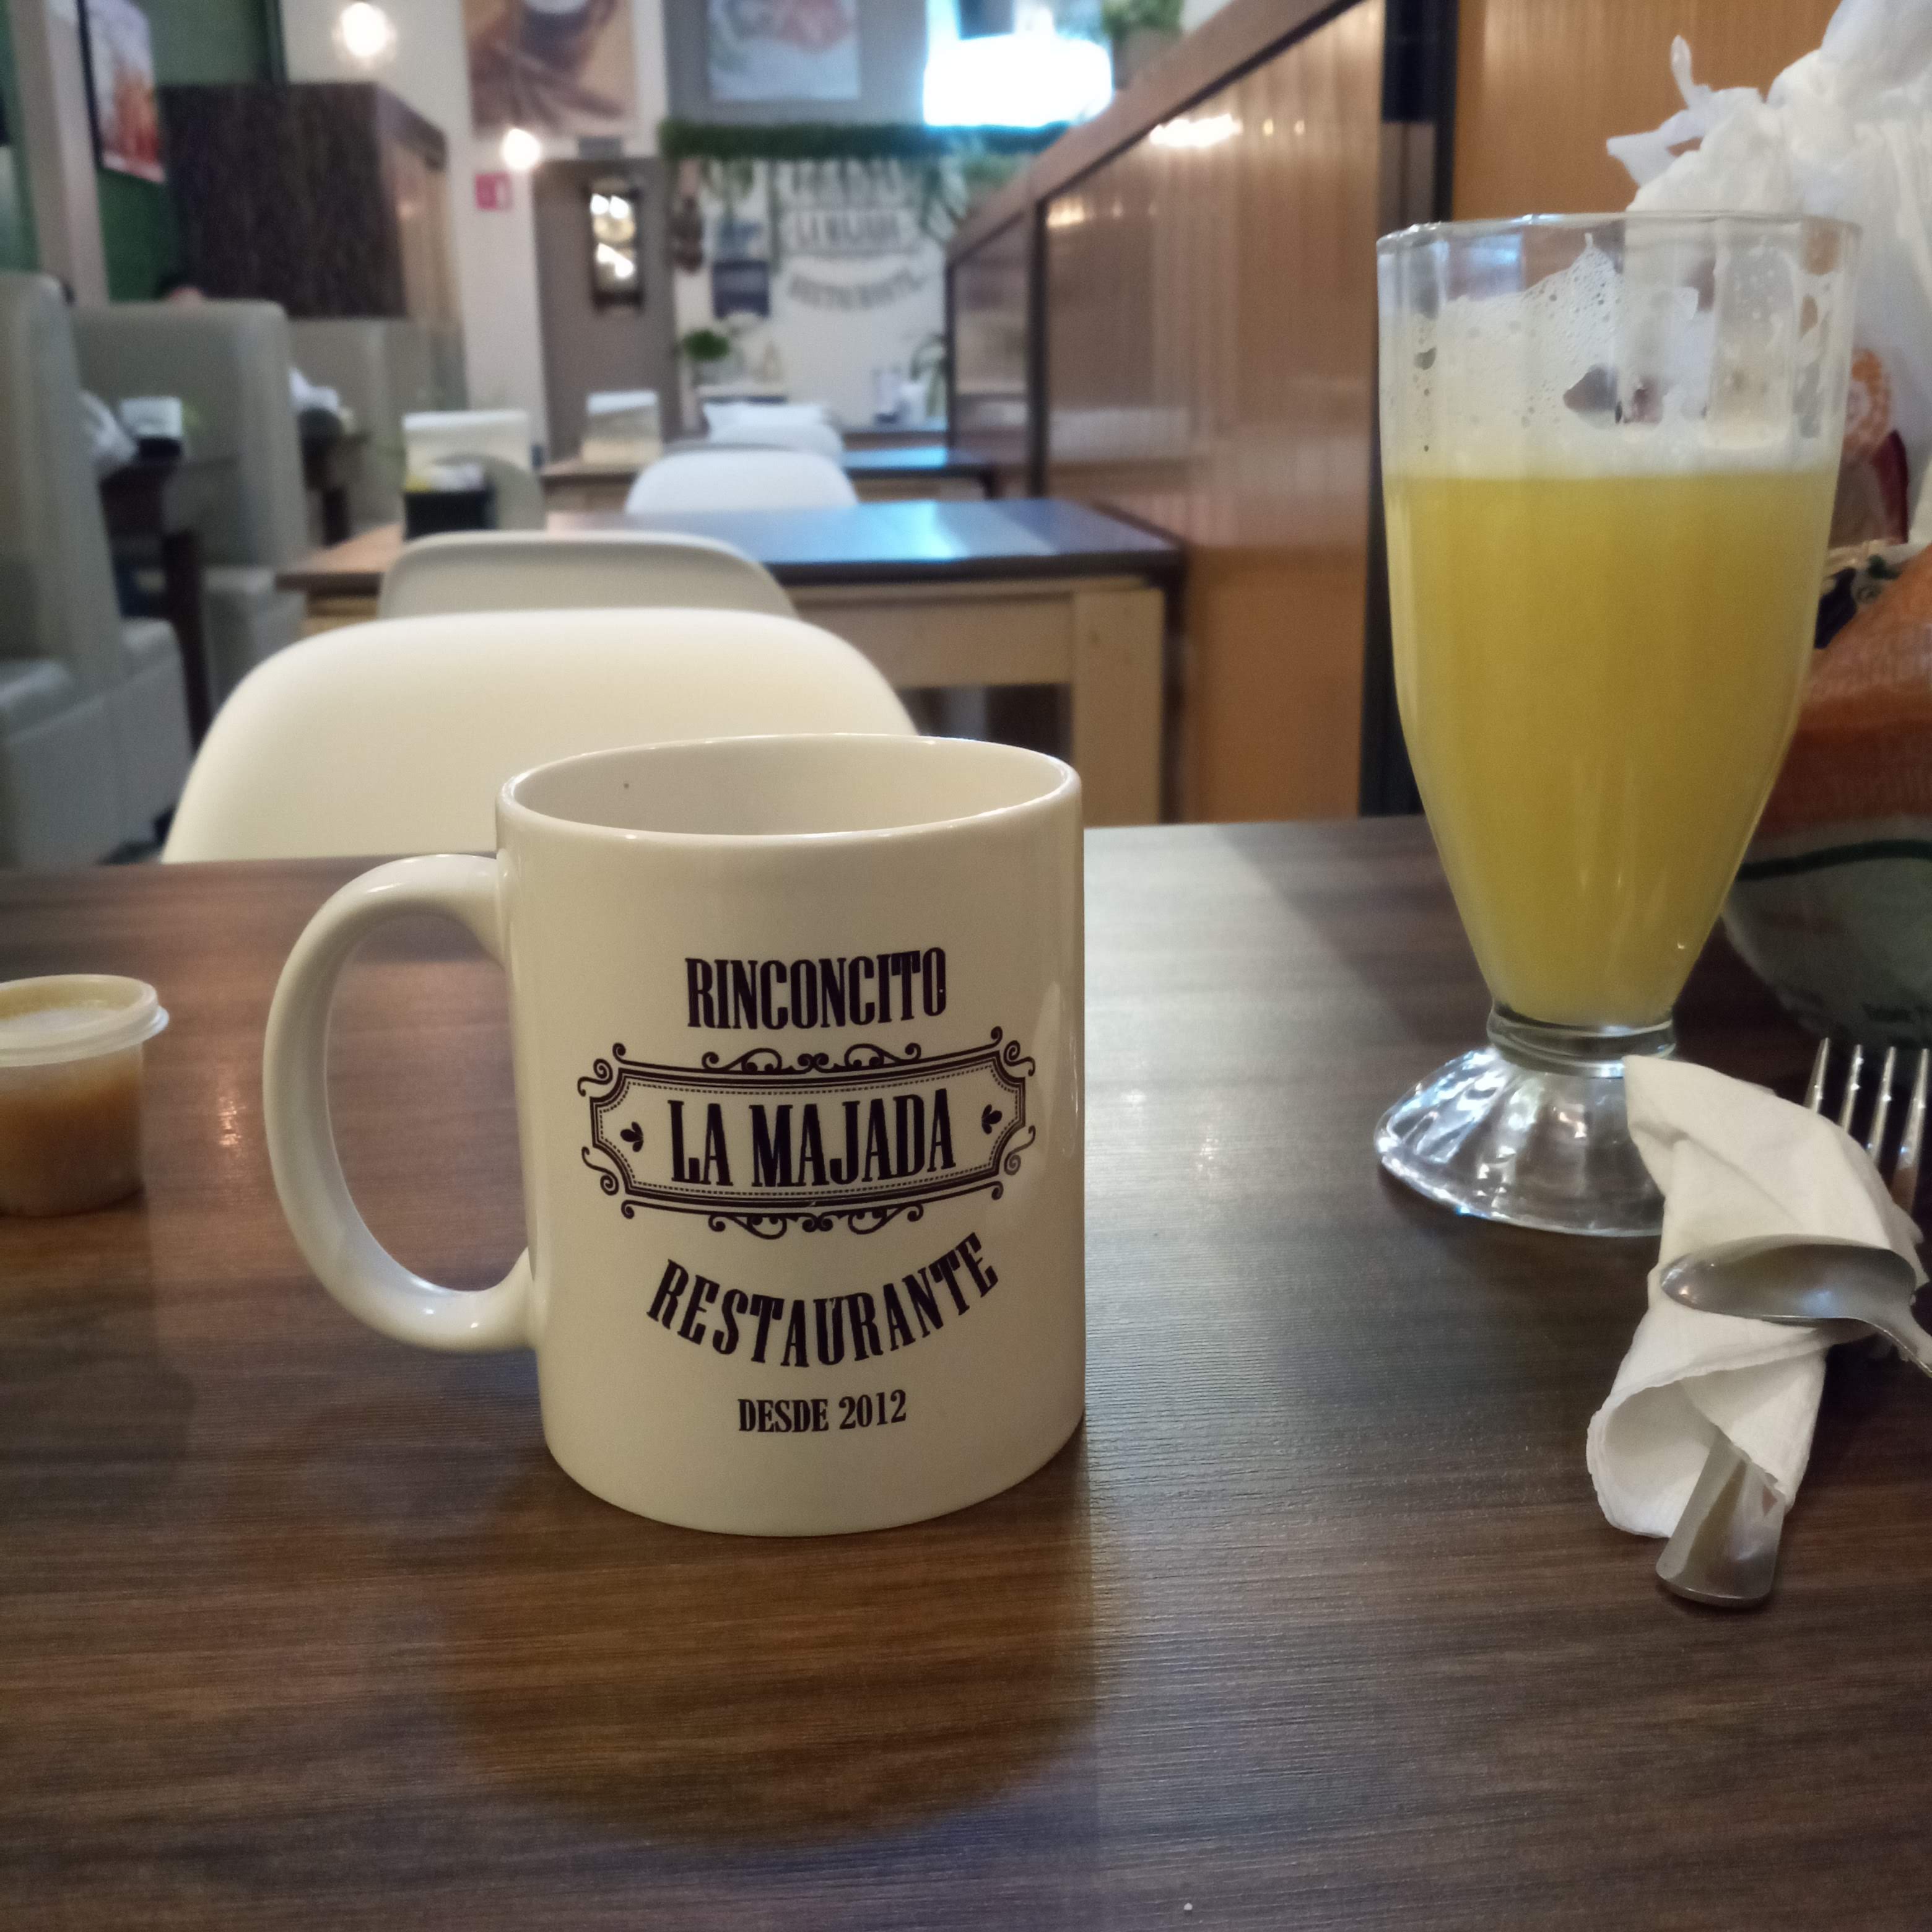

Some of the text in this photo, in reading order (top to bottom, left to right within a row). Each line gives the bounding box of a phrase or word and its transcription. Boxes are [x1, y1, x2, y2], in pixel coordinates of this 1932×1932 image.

[685, 947, 947, 1030] RINCONCITO
[668, 1088, 957, 1187] LA MAJADA
[646, 1232, 999, 1368] RESTAURANTE
[738, 1389, 907, 1433] DESDE 2012
